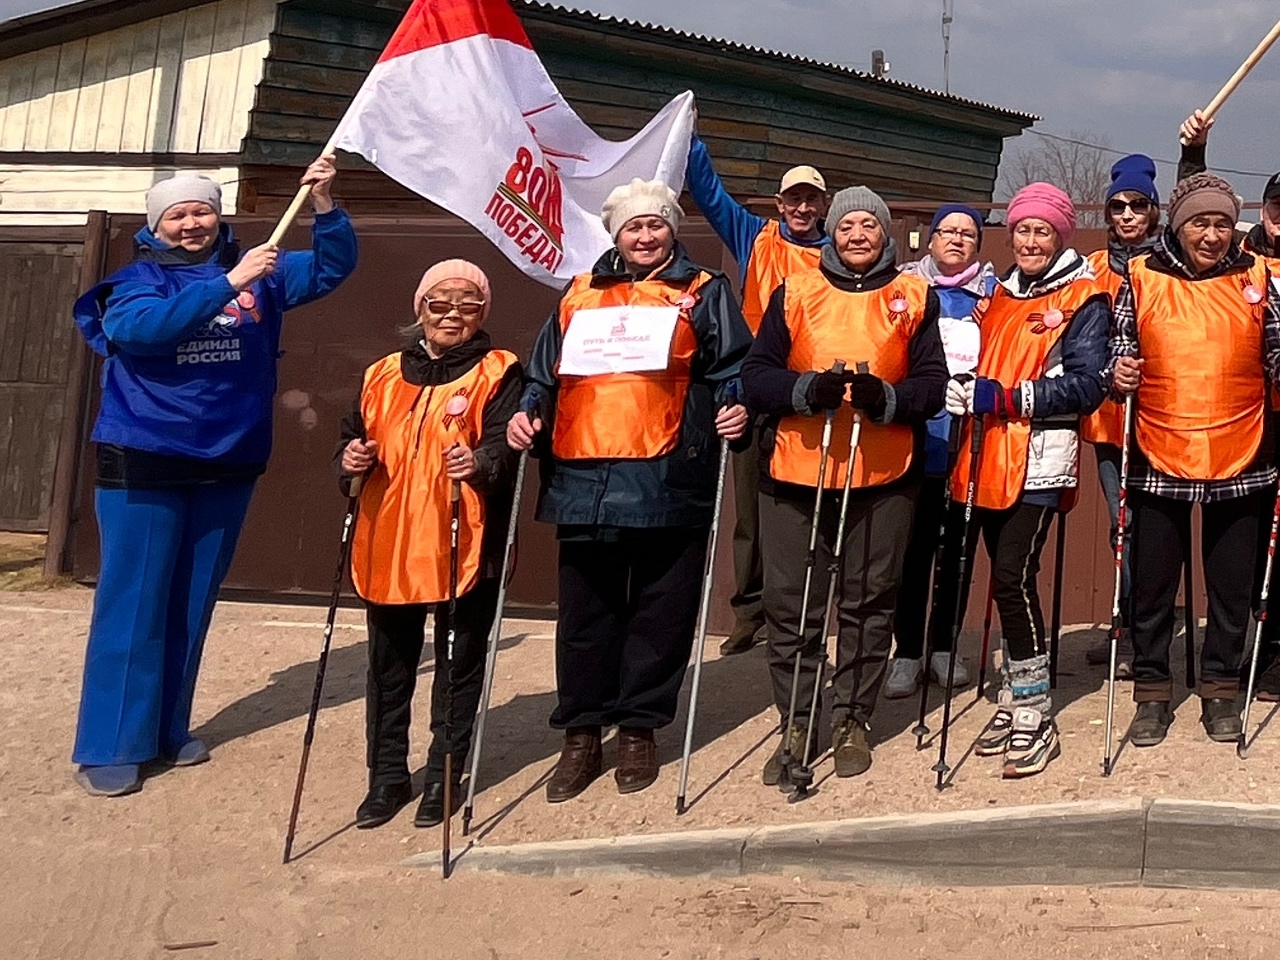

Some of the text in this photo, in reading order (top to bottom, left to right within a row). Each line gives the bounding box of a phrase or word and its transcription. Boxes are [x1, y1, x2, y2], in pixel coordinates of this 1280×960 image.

[484, 191, 564, 275] ПОБЕДА!
[176, 338, 240, 353] ЕДИНАЯ
[176, 350, 241, 365] РОССИЯ
